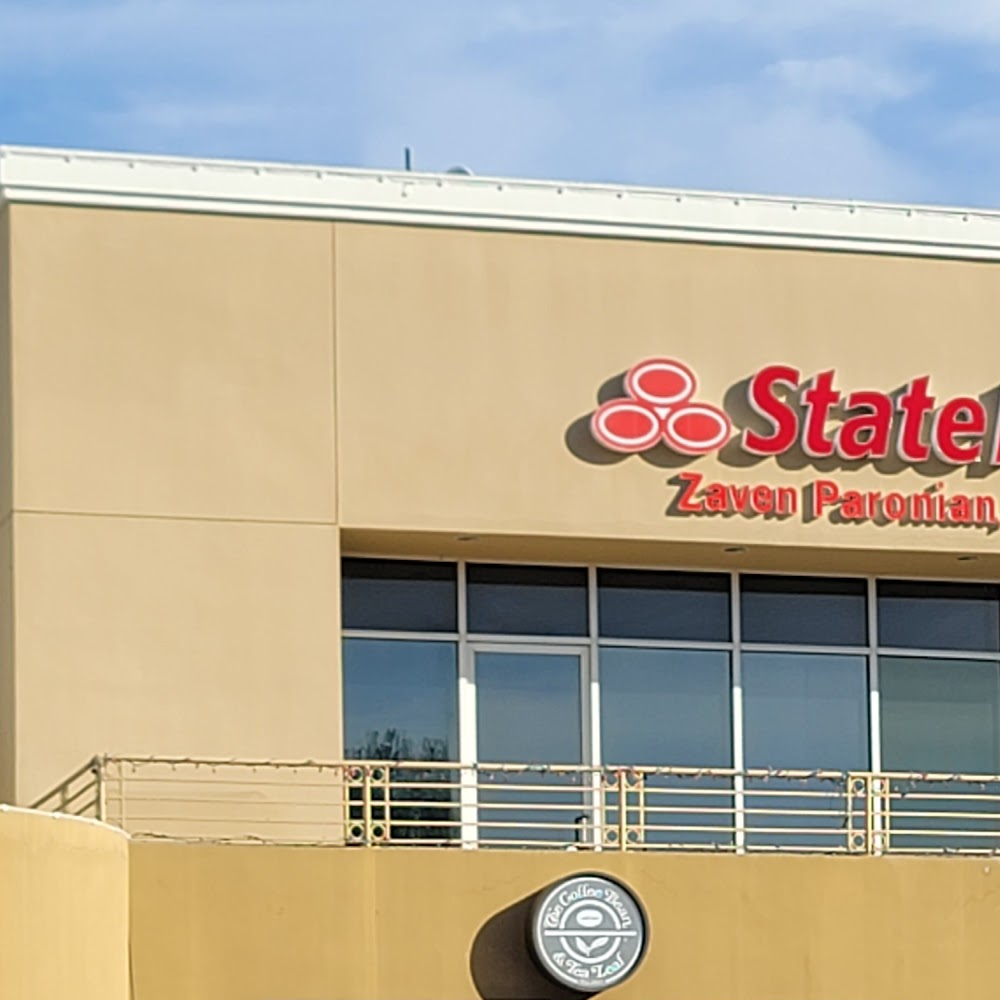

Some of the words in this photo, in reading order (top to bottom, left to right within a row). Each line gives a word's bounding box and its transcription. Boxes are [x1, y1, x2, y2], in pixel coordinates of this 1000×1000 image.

[677, 472, 798, 516] Zaven
[559, 884, 603, 906] Coffee
[605, 888, 632, 928] Bean
[590, 951, 624, 978] Leaf
